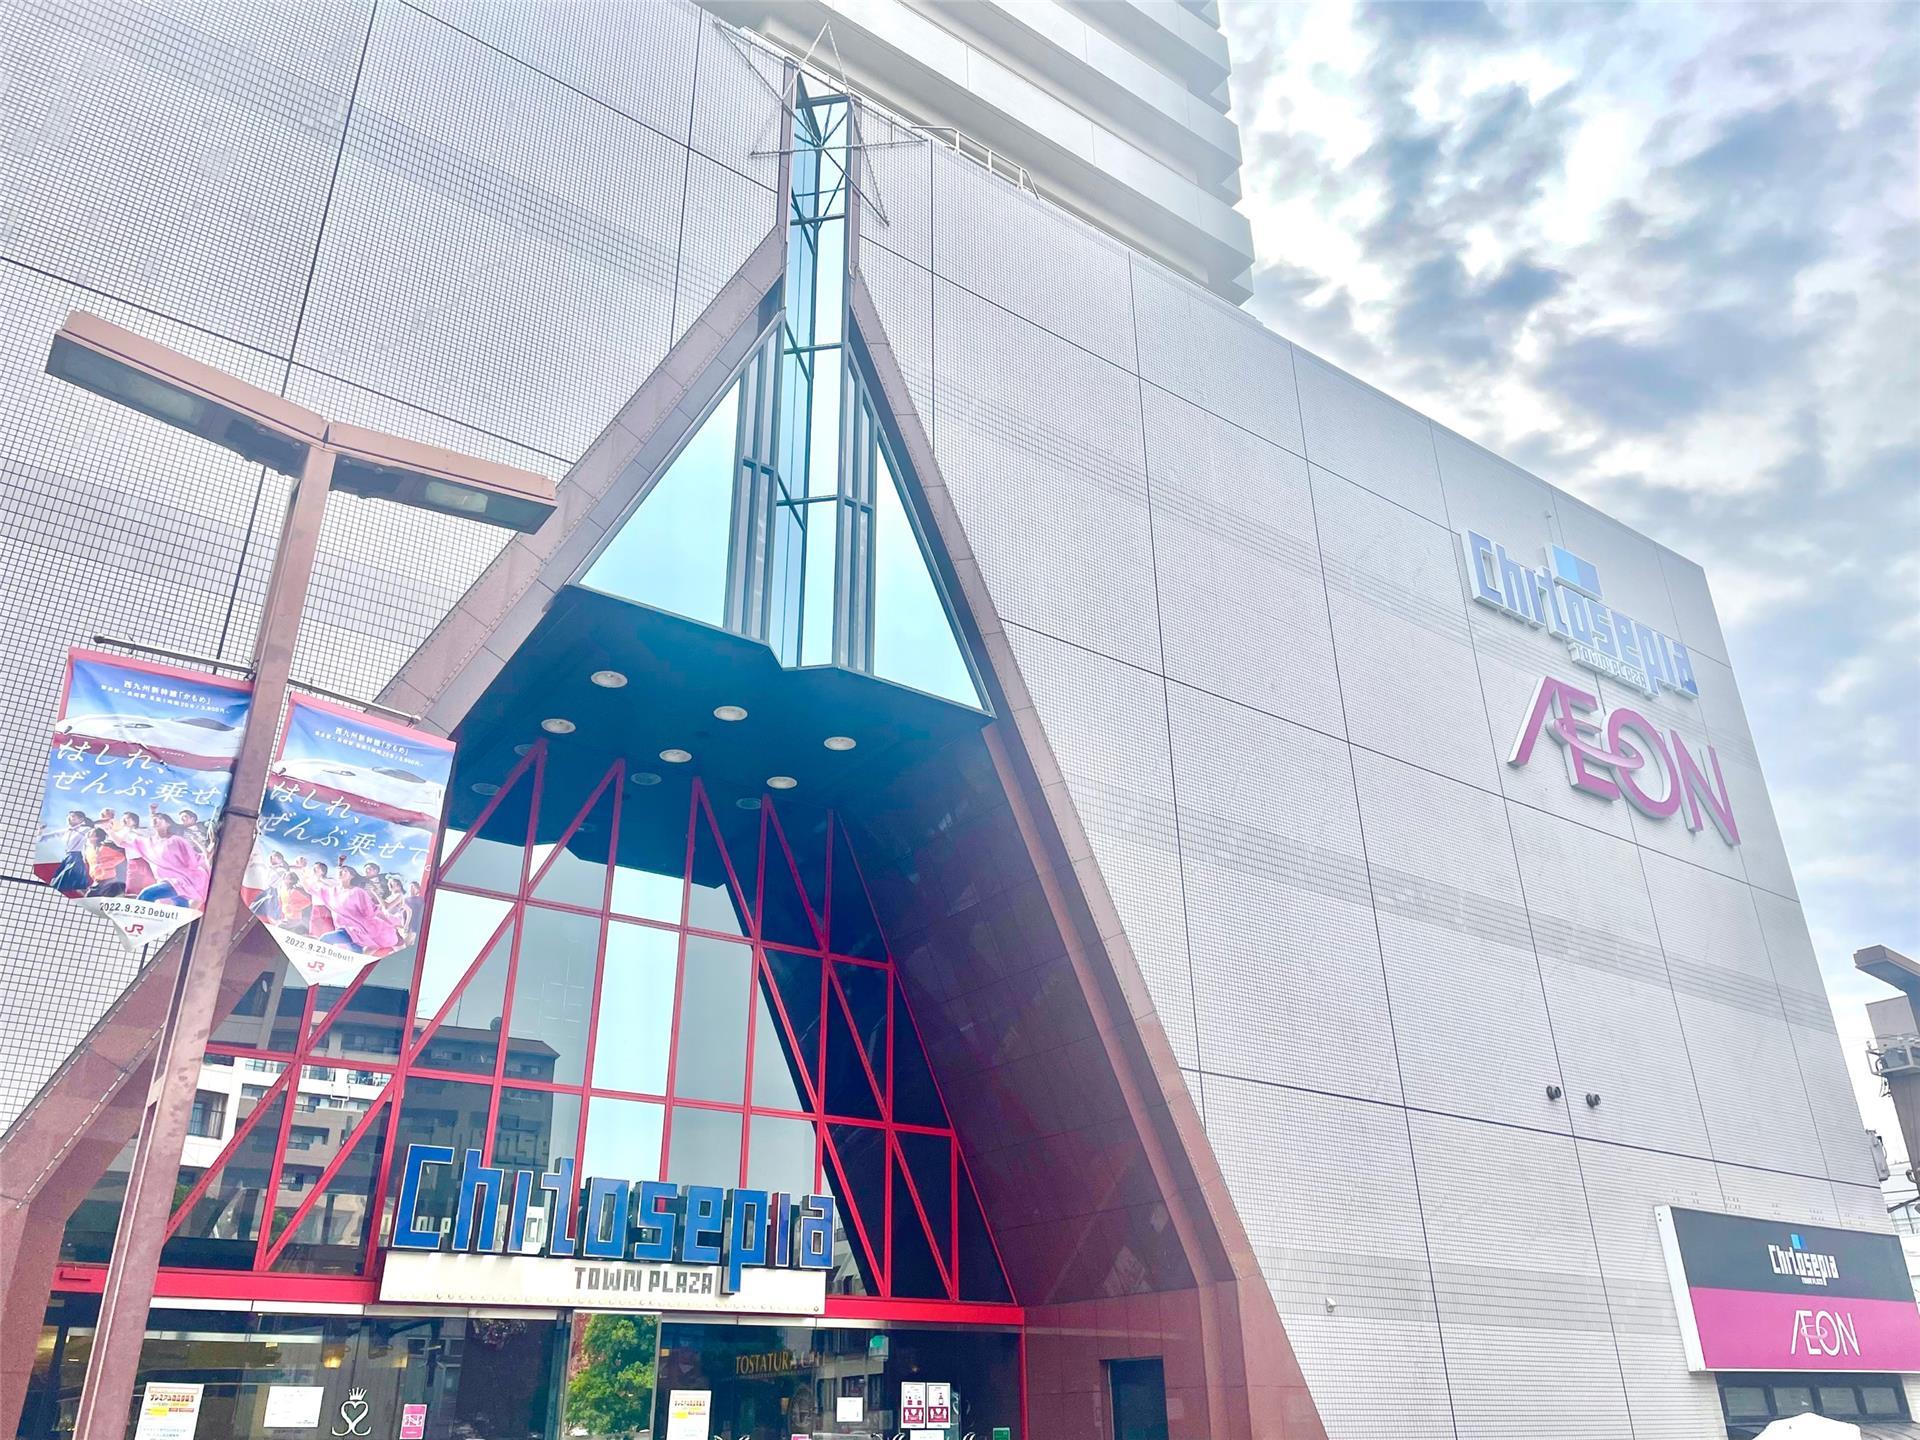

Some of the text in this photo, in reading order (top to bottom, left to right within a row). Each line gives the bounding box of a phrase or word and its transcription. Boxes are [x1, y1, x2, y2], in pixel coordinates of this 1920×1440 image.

[1463, 530, 1699, 698] Chitosepia
[56, 738, 168, 775] はしれ、
[53, 769, 228, 806] ぜんぶ乗せ
[270, 781, 359, 825] はしれ、
[100, 902, 147, 916] 2022.9.23
[147, 907, 179, 921] Debut!
[125, 924, 145, 935] JR
[284, 936, 327, 955] 2022.9.23
[327, 948, 355, 963] Debut!
[307, 960, 326, 971] JR
[392, 1143, 836, 1294] Chitosepia
[574, 1266, 713, 1295] TOWN PLAZA
[1767, 1244, 1840, 1287] Chitosepia
[736, 1351, 798, 1375] TOSTATURA
